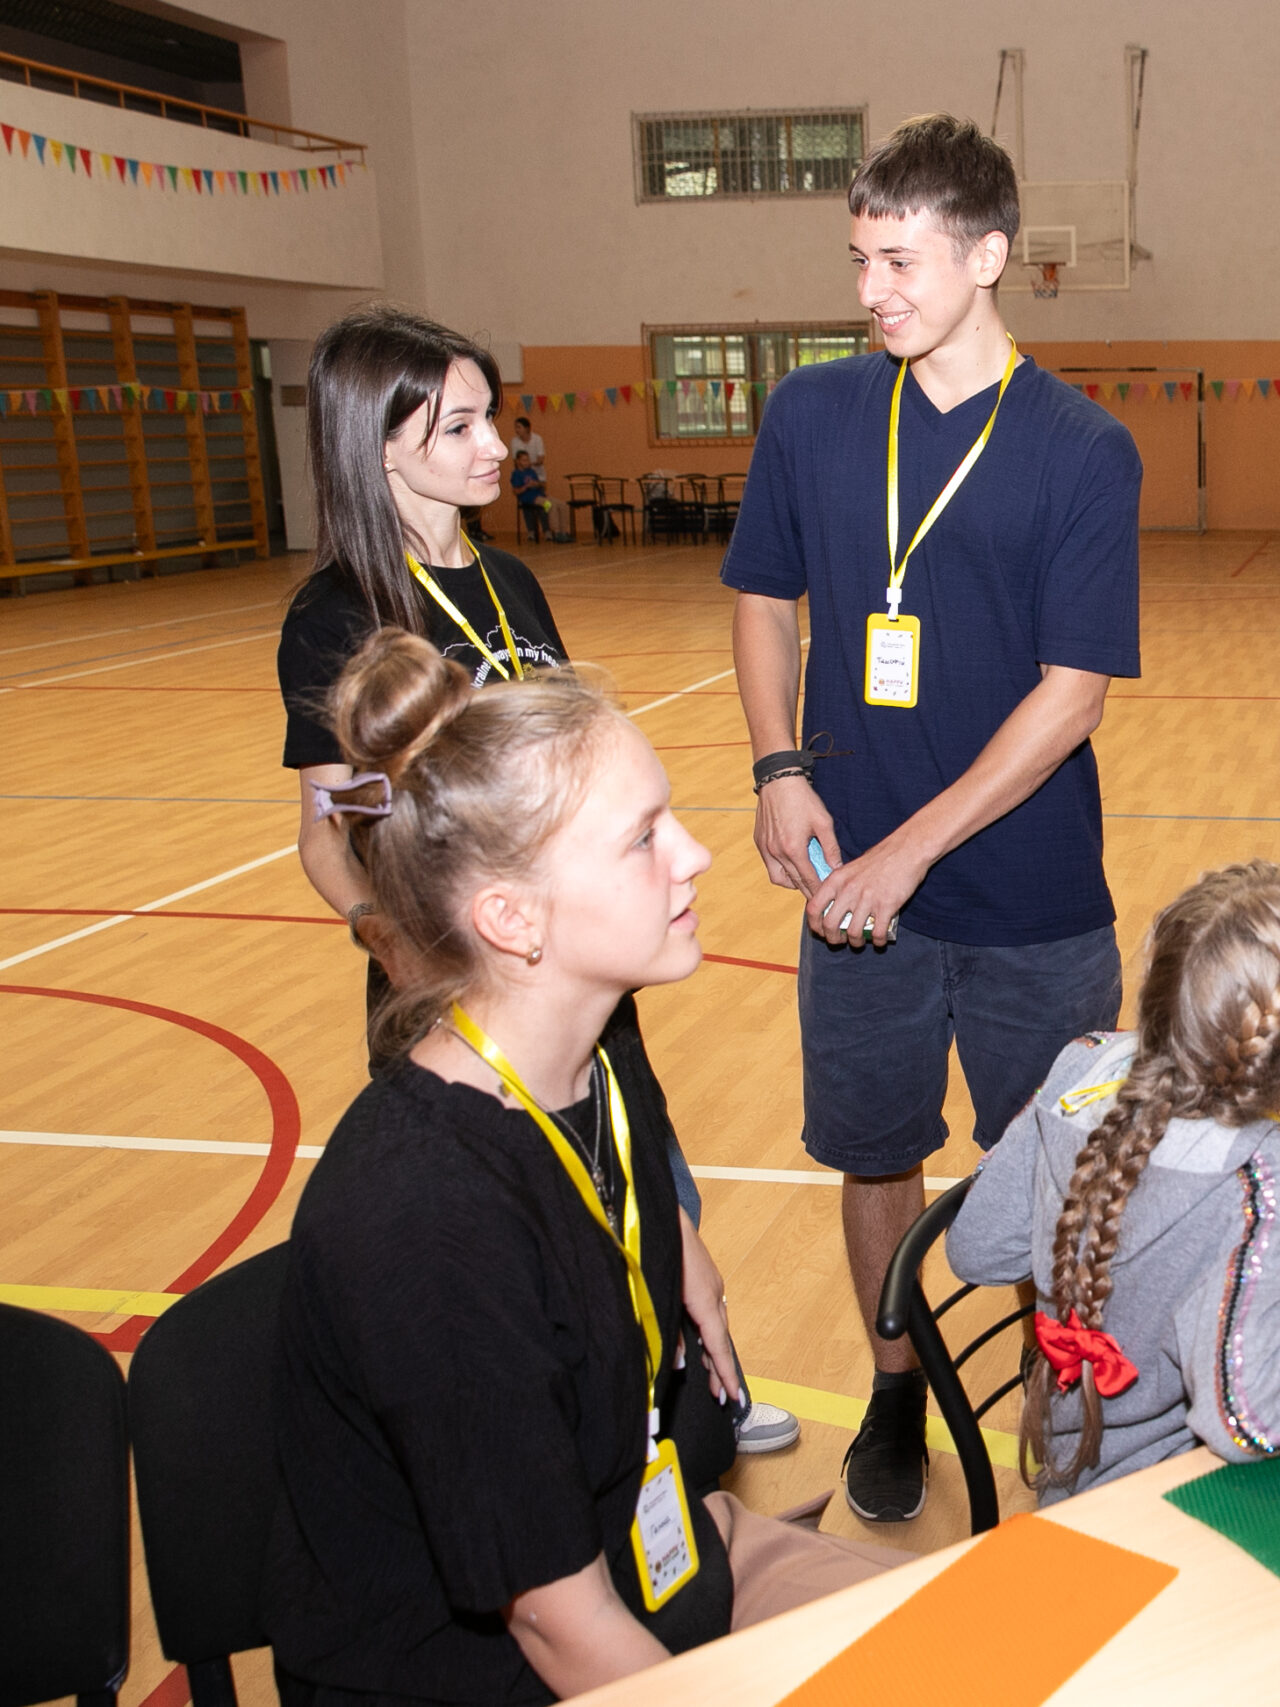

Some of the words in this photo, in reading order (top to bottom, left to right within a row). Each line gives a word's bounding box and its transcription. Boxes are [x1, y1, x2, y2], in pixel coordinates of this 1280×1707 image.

[470, 661, 491, 689] kraine
[525, 648, 539, 661] my
[541, 650, 560, 669] hea
